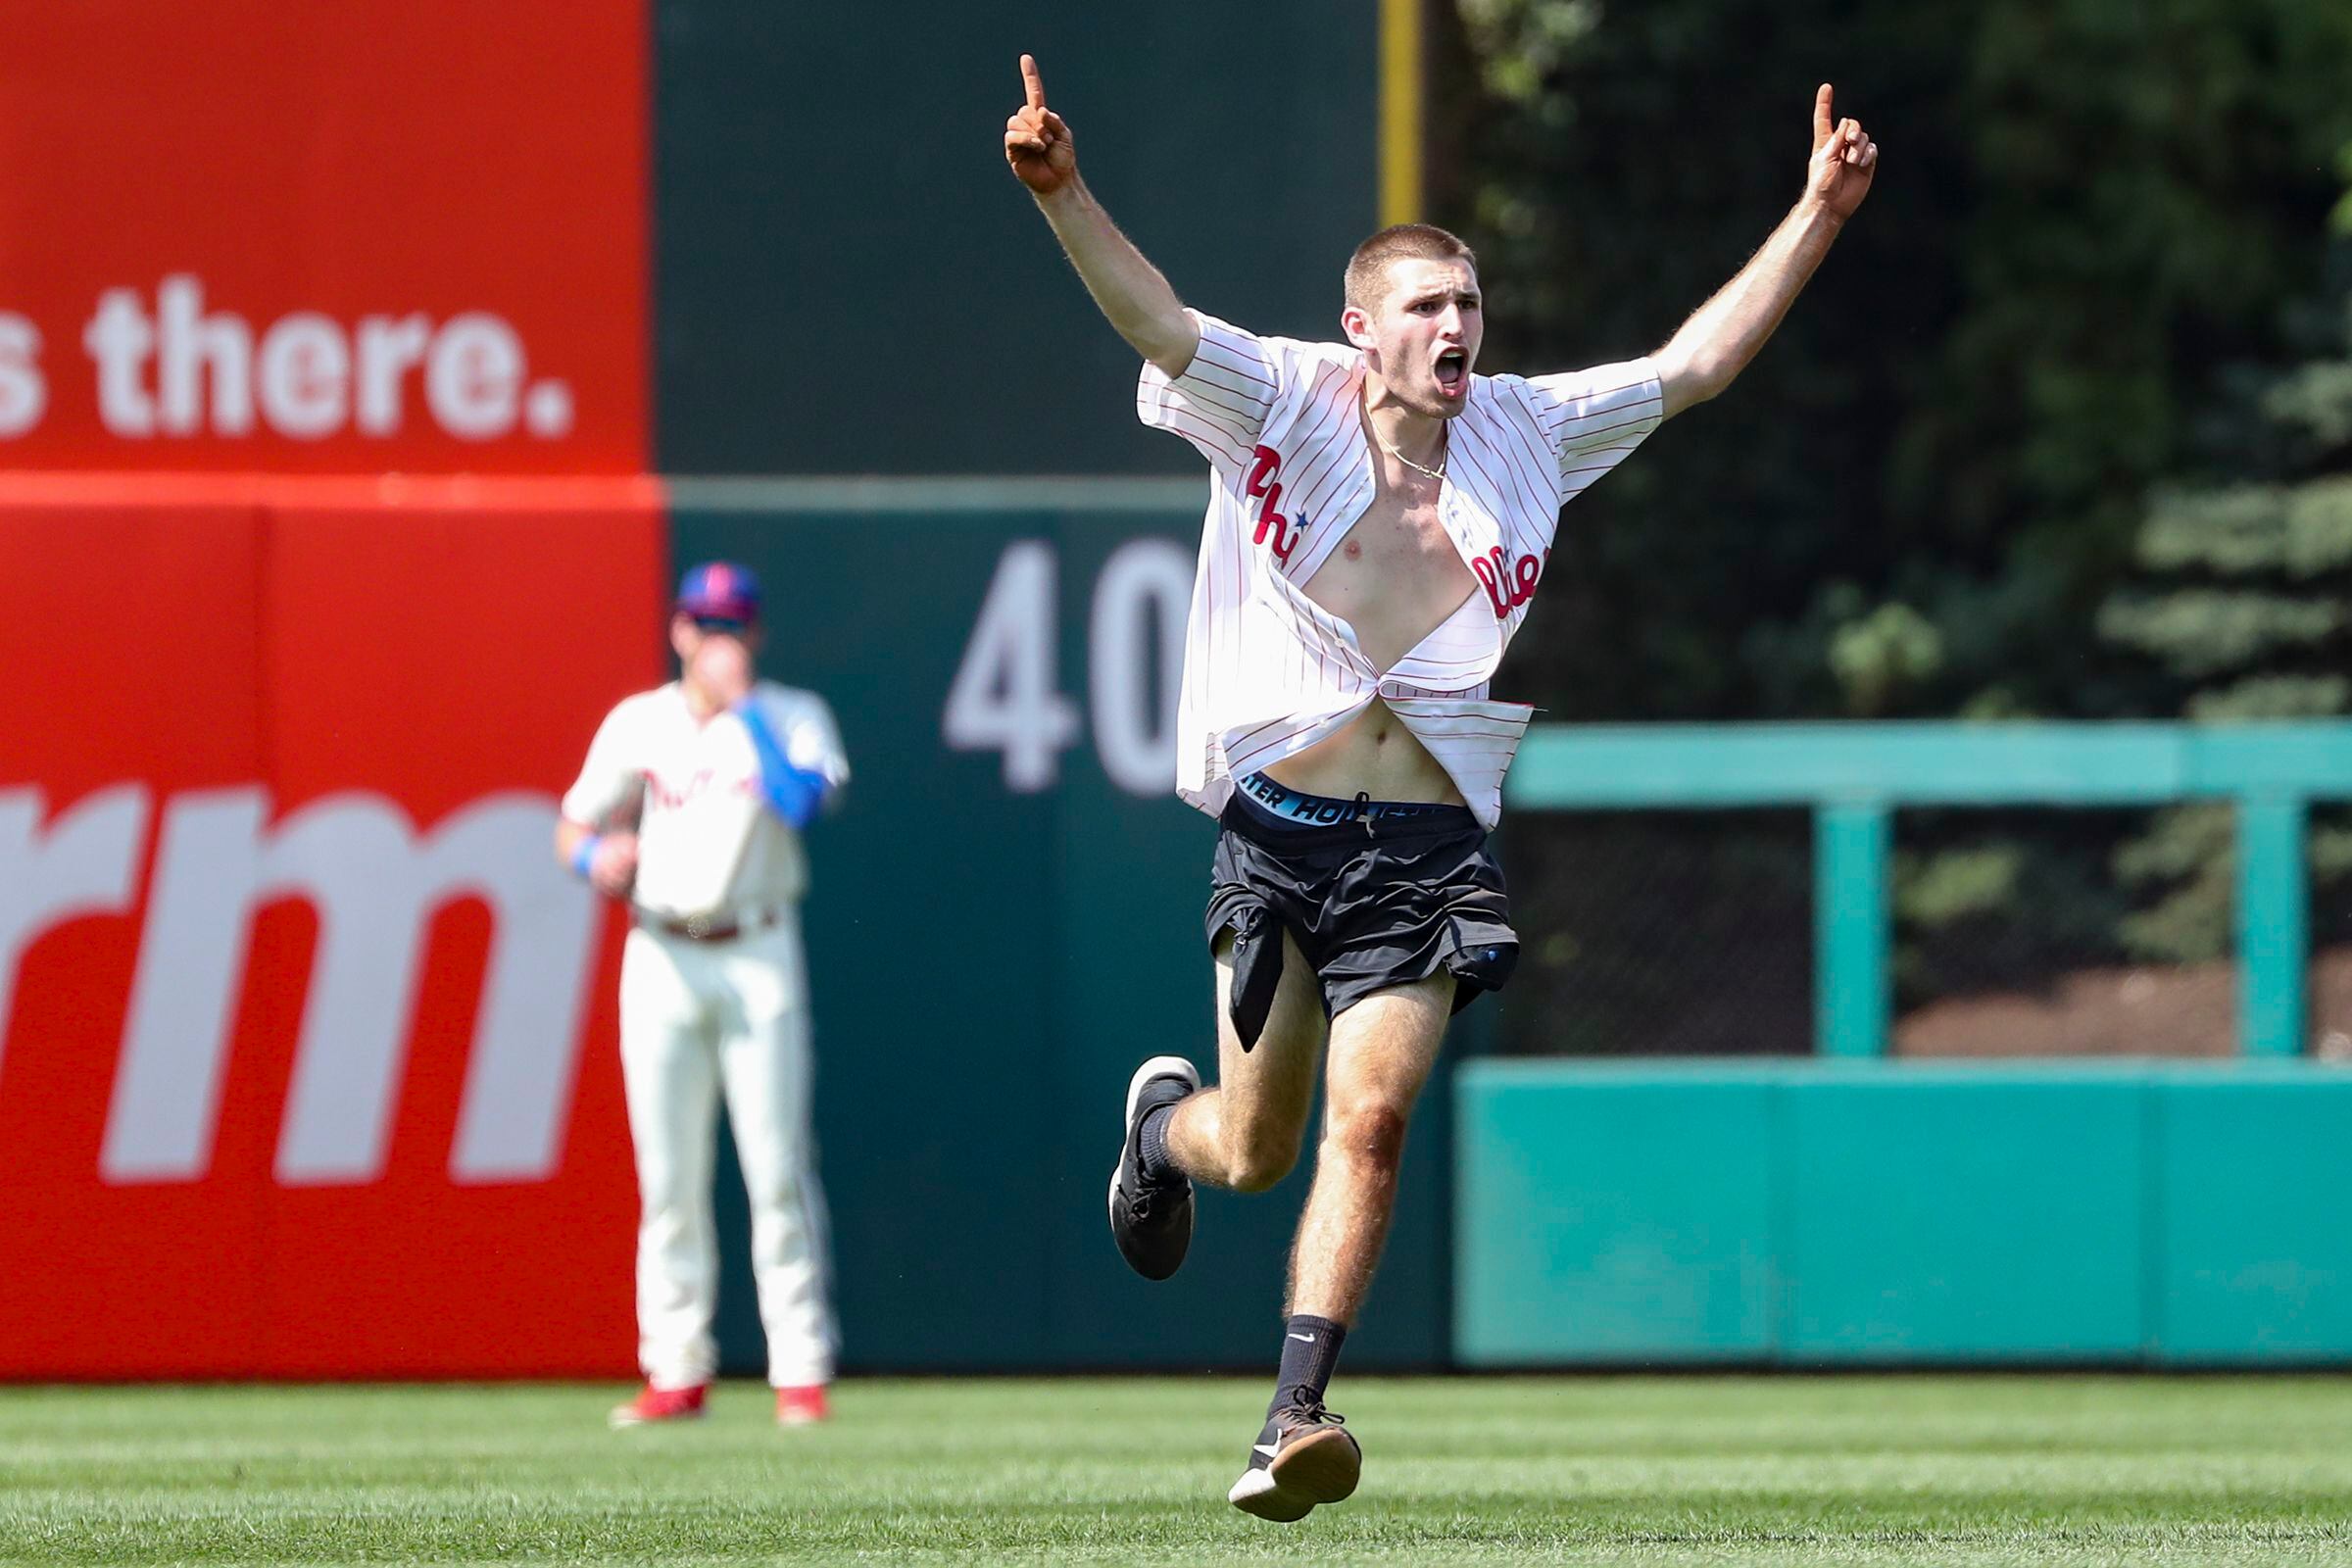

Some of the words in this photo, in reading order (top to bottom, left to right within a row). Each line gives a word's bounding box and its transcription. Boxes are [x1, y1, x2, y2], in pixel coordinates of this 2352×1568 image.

[83, 272, 575, 440] there.
[941, 537, 1196, 796] 40
[1240, 772, 1287, 809] TER
